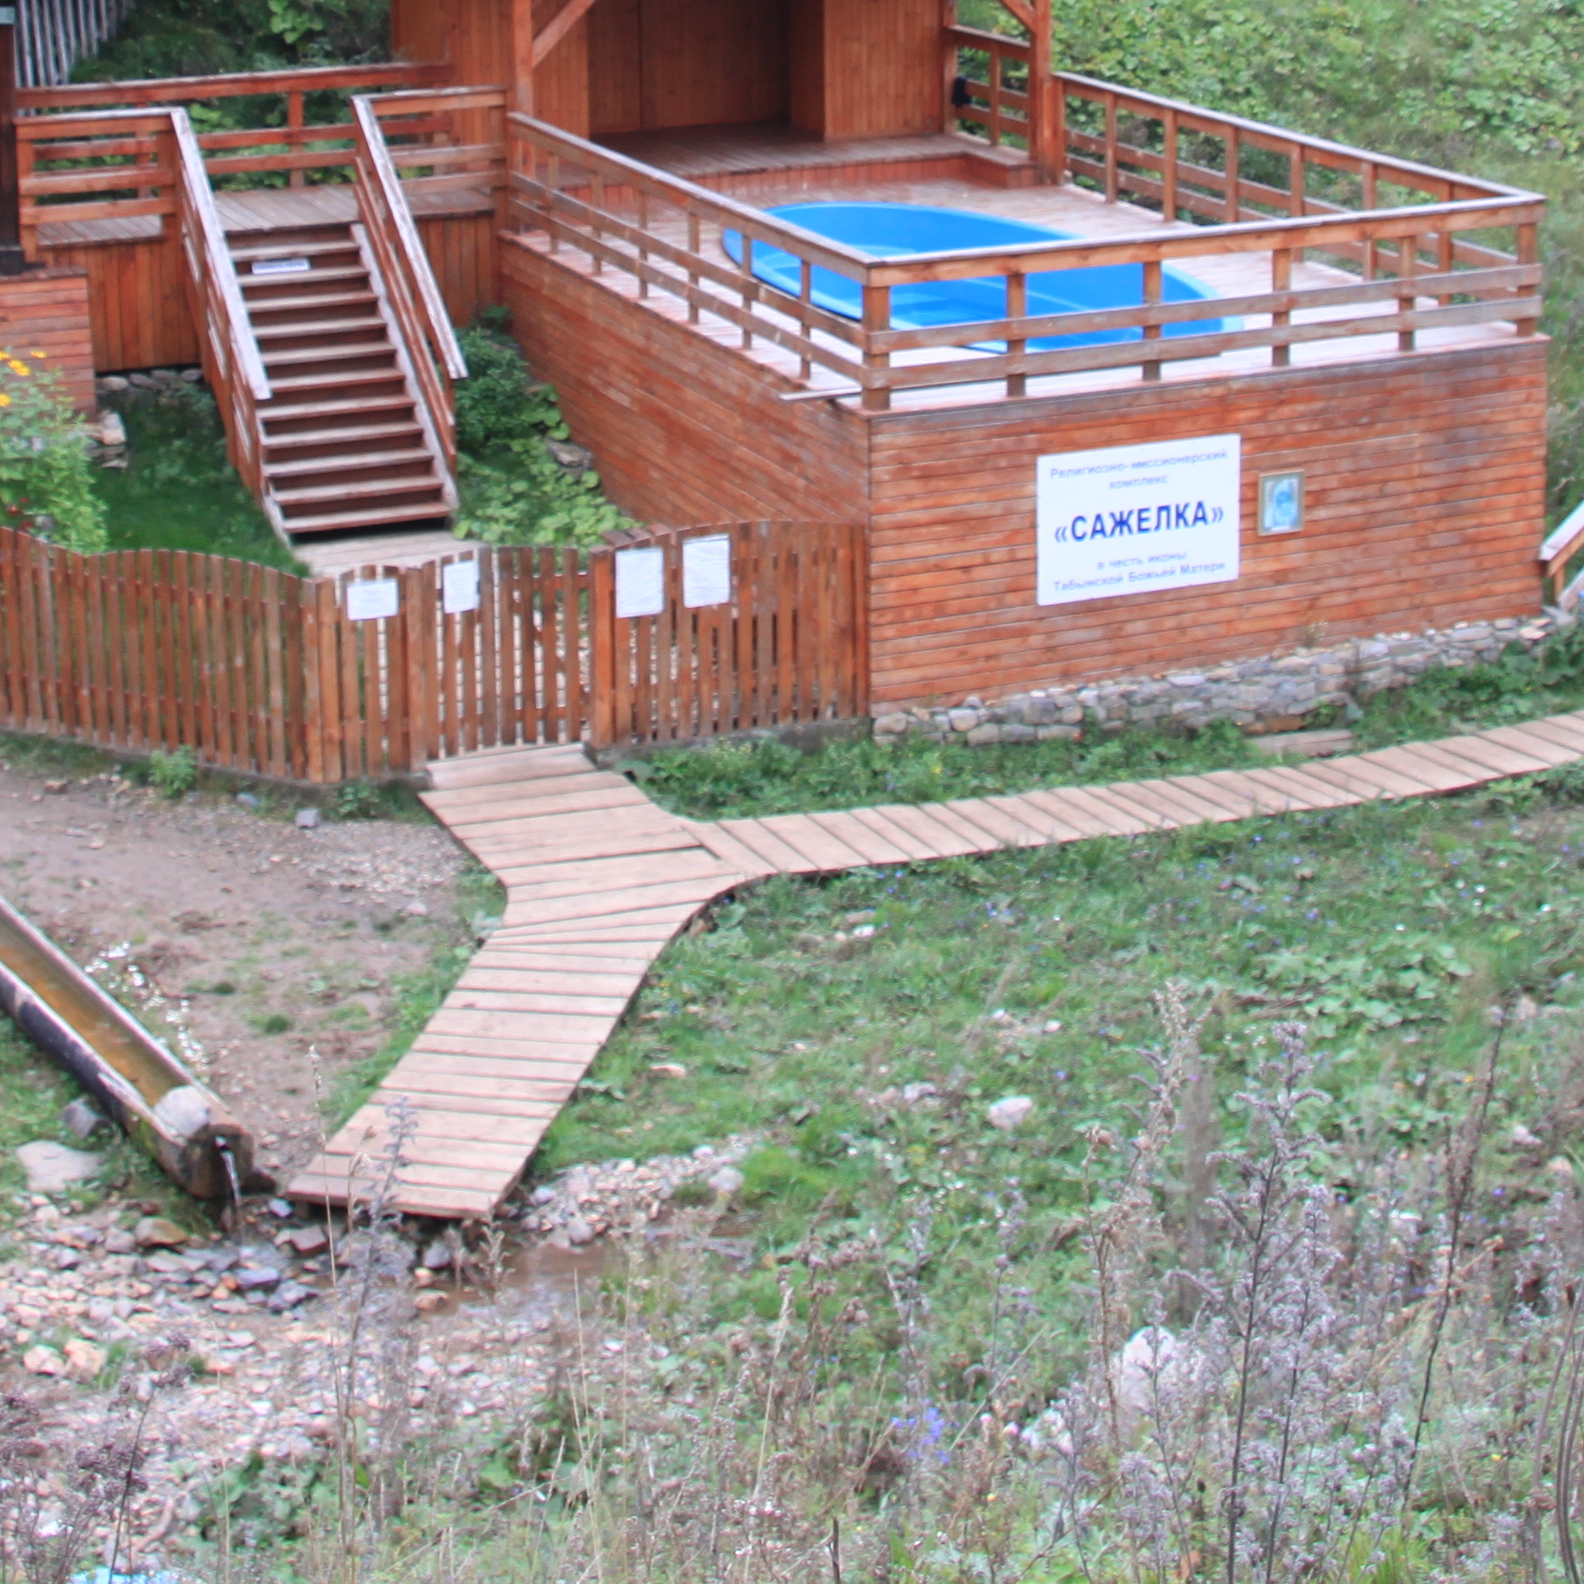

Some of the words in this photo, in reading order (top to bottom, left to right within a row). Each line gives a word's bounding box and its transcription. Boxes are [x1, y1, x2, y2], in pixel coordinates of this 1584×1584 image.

[1109, 475, 1168, 490] комплекс
[1054, 500, 1224, 543] «САЖЕЛКА»
[1148, 552, 1187, 563] иконы
[1128, 568, 1176, 583] Божьей
[1180, 561, 1227, 576] Матери
